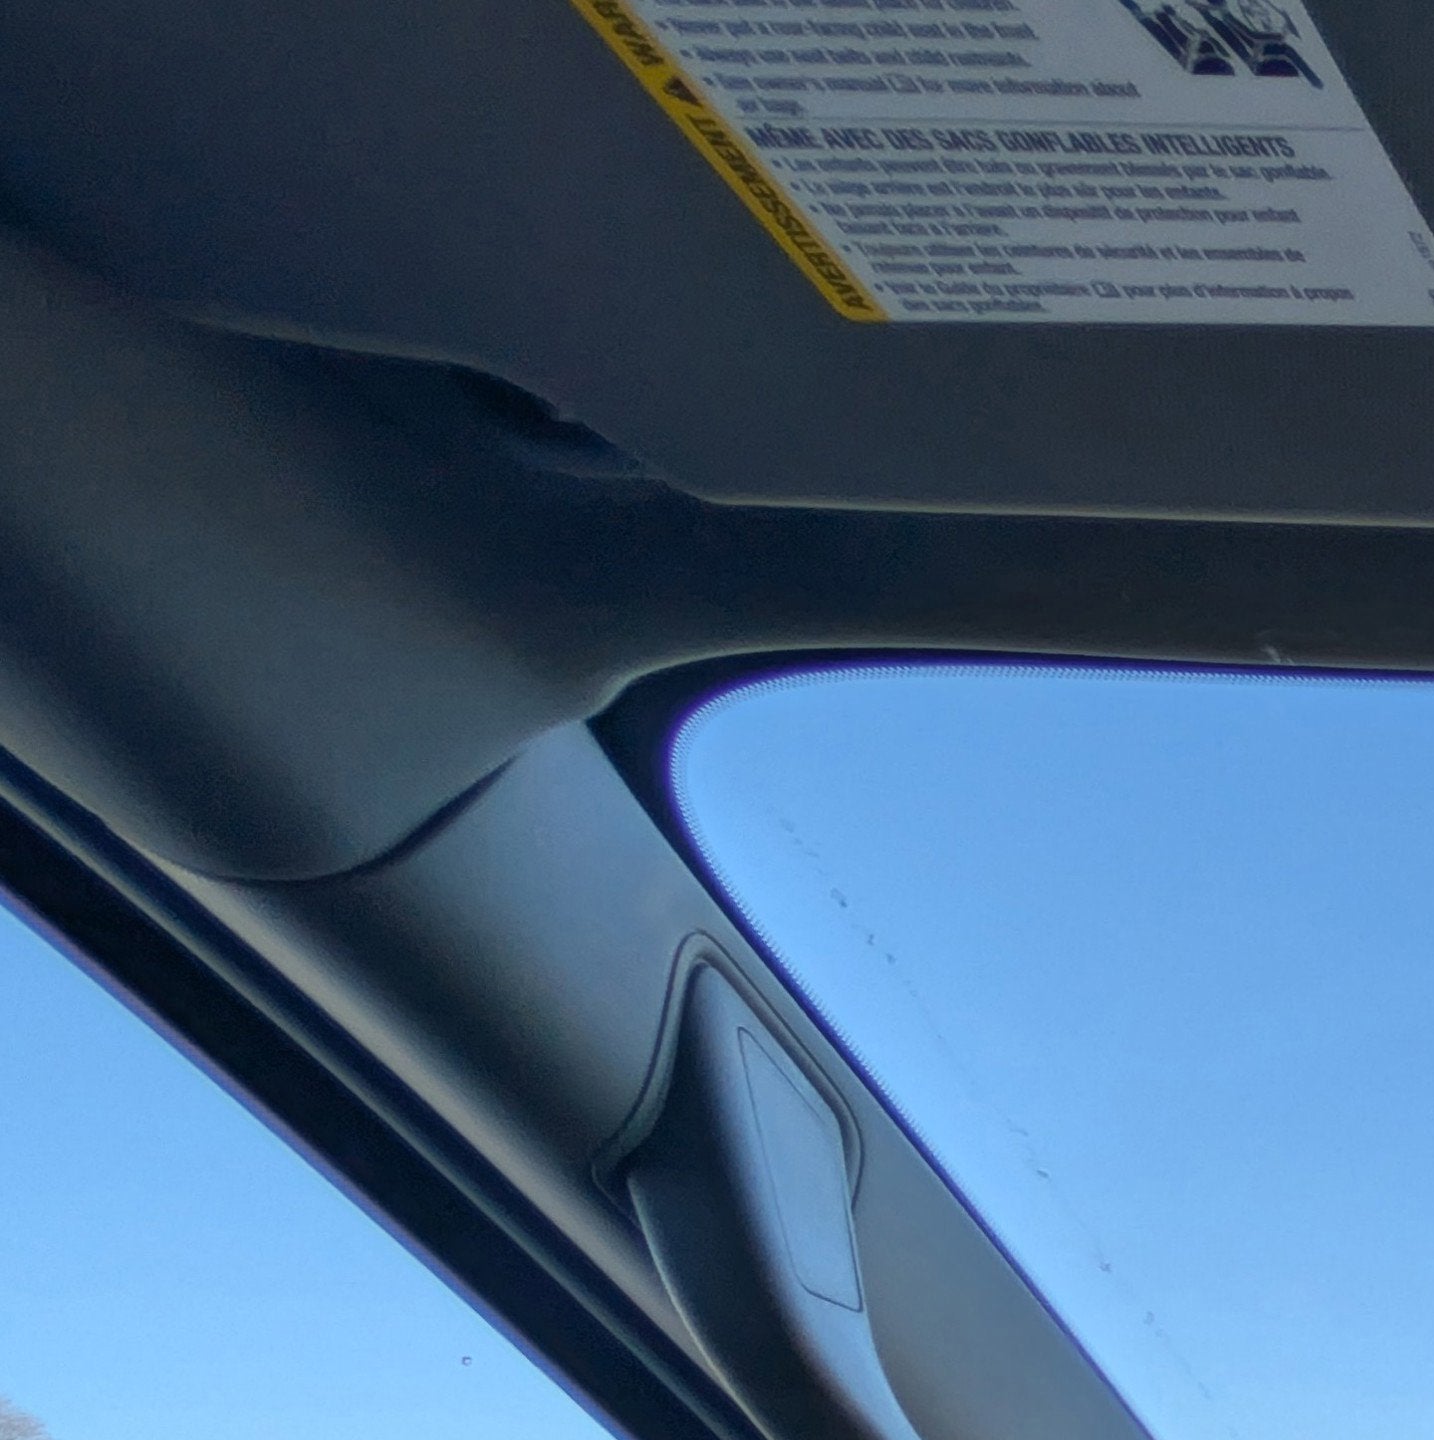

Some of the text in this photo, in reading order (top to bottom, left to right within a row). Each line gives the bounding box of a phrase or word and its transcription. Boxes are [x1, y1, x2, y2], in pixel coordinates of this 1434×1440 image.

[821, 127, 883, 151] AVEC
[882, 128, 932, 152] DES
[932, 129, 996, 152] SACS
[996, 130, 1142, 154] GONFLABLES
[1141, 134, 1296, 158] INTELLIGENTS
